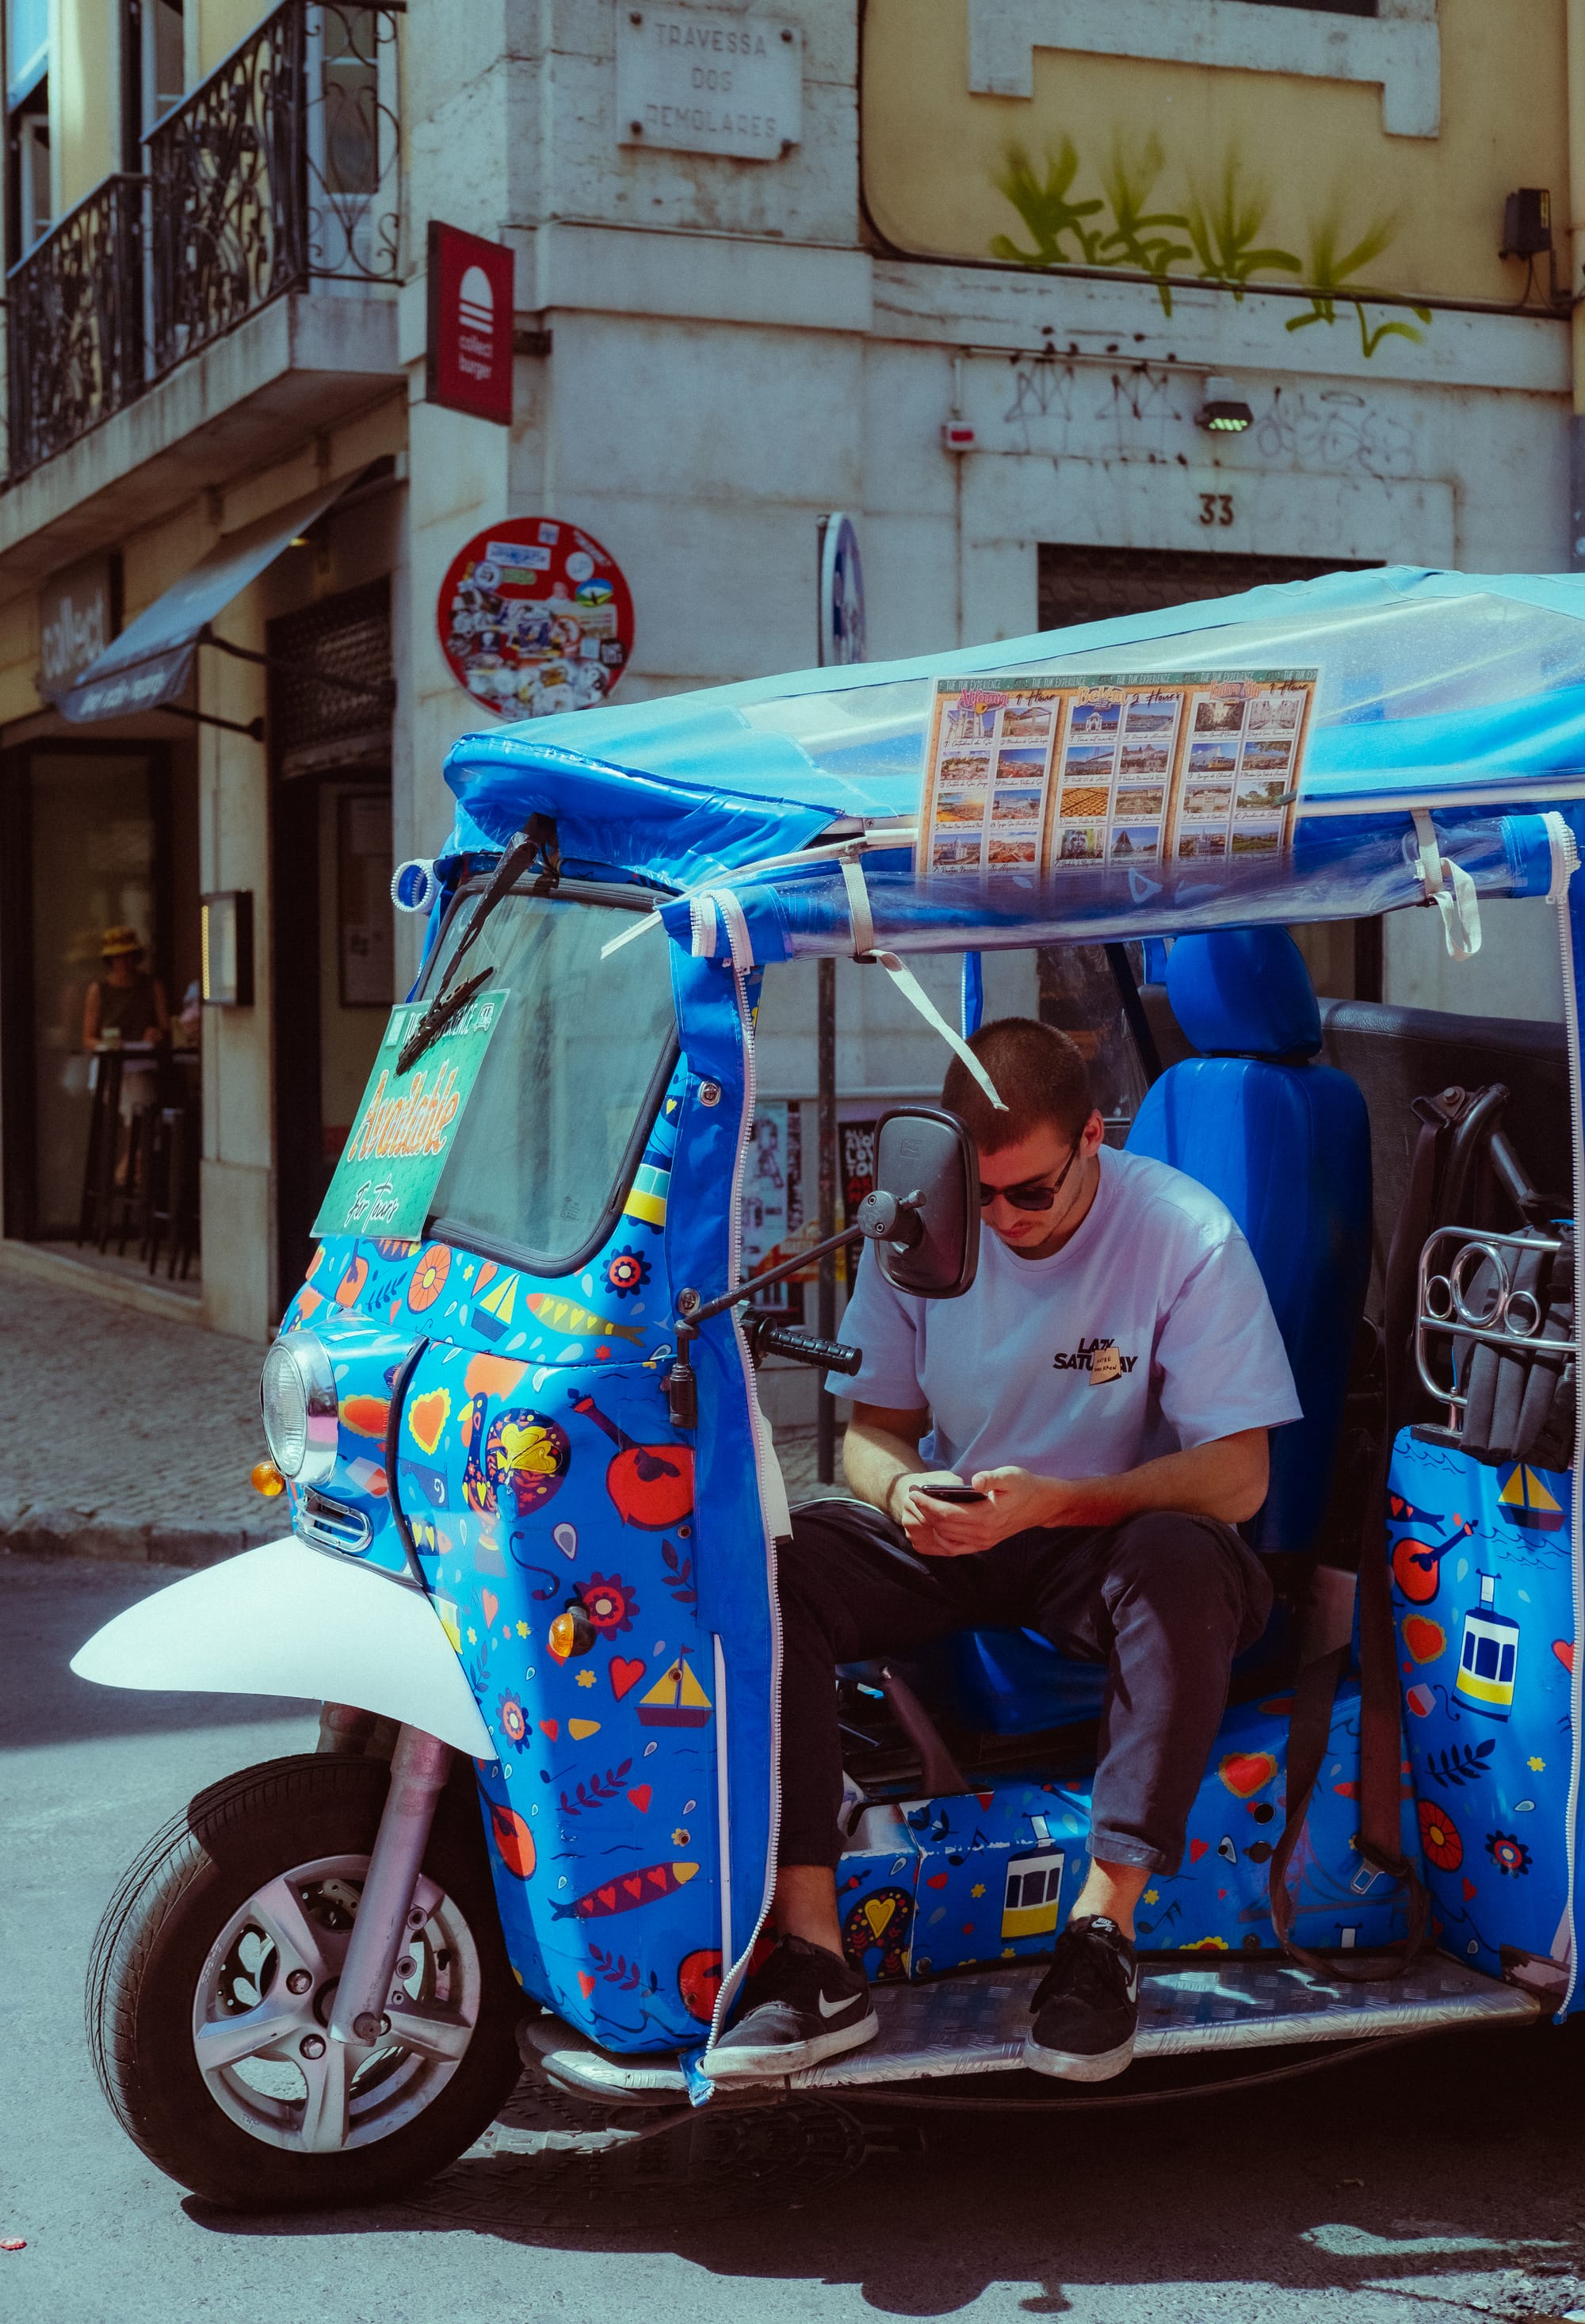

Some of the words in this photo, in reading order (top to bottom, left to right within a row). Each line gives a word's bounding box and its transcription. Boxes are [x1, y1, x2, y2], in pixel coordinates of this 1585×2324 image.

[655, 24, 766, 55] TRAVESSA
[693, 67, 732, 91] DOS
[458, 354, 492, 380] burger
[1199, 494, 1233, 525] 33
[970, 678, 1002, 690] EXPERIENCE
[1054, 676, 1087, 686] EXPERIENCE
[1139, 673, 1171, 684] EXPERIENCE
[958, 689, 1009, 709] Alfama
[1077, 686, 1128, 707] Belém
[1130, 694, 1140, 708] 2
[348, 1058, 460, 1162] Available
[344, 1179, 372, 1228] For
[361, 1173, 399, 1233] Tours
[1078, 1337, 1115, 1354] LAZY
[1052, 1352, 1139, 1373] SATUAY
